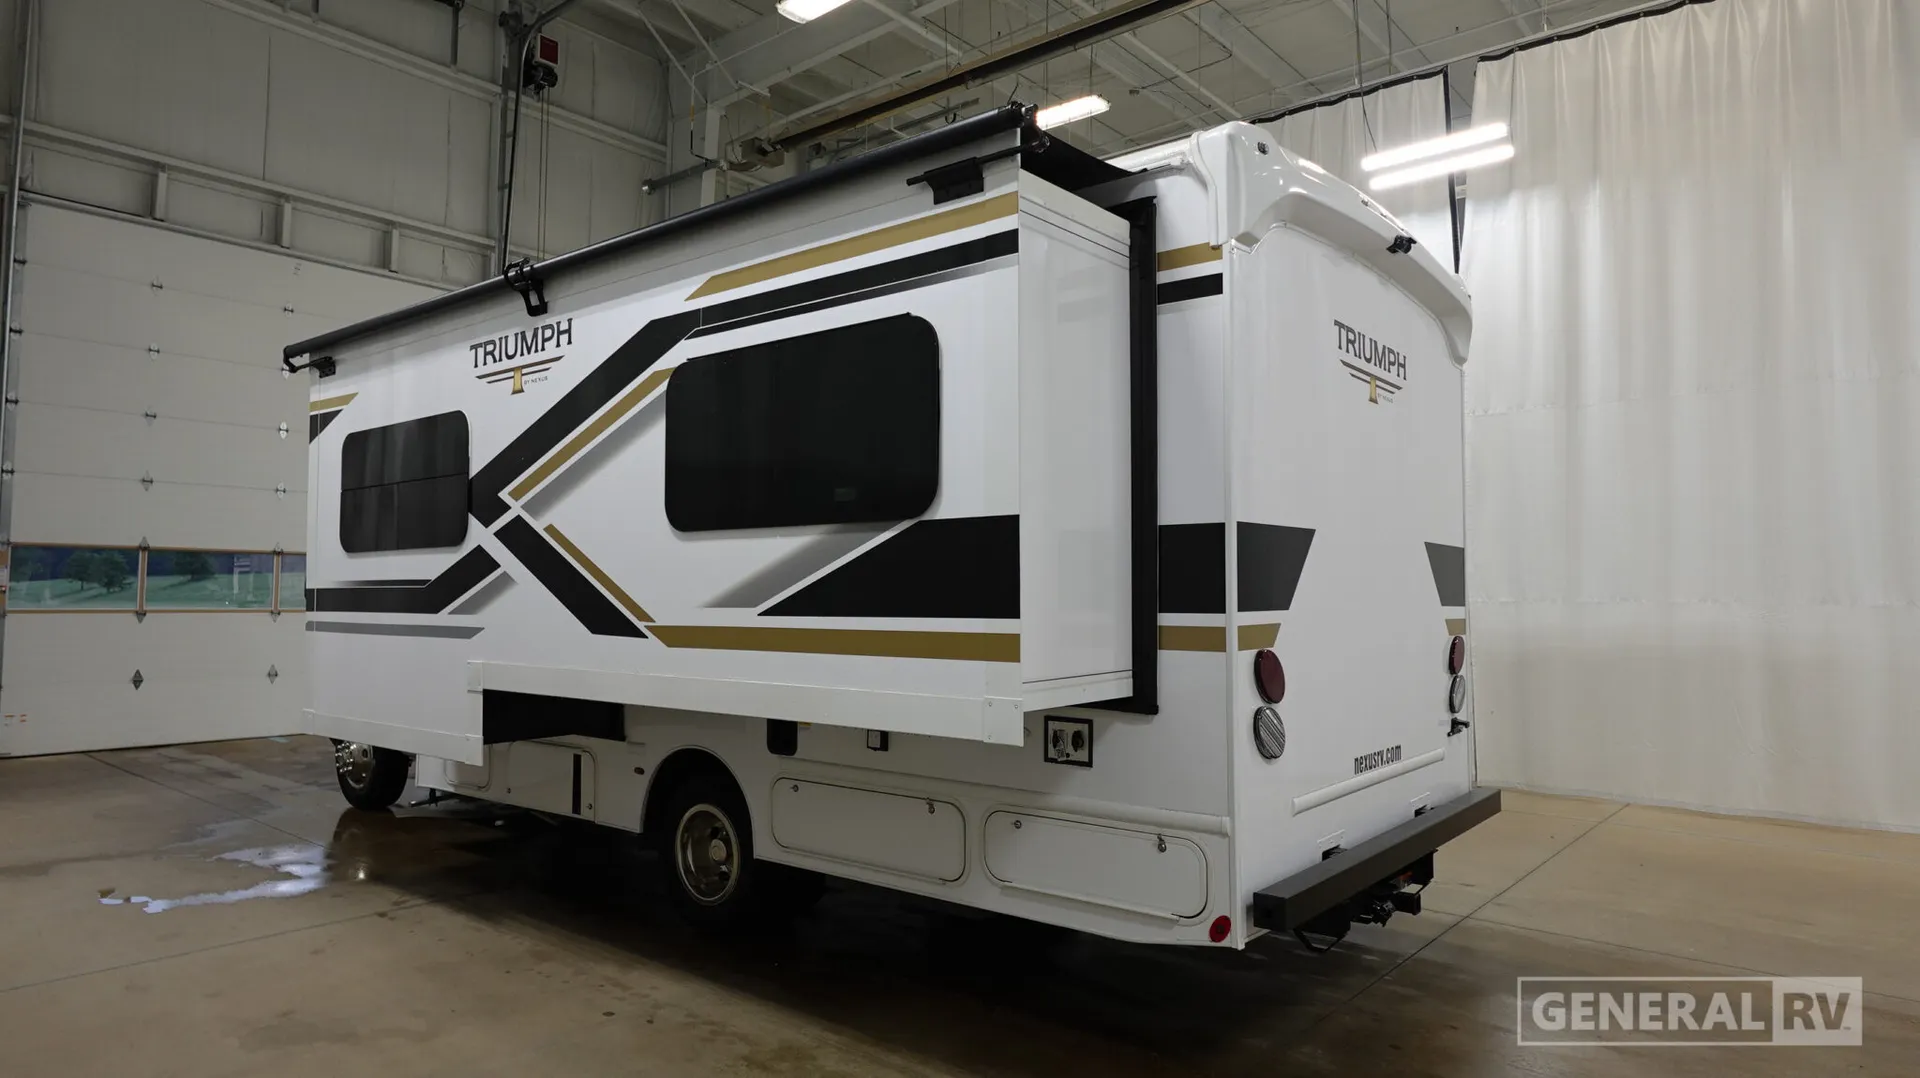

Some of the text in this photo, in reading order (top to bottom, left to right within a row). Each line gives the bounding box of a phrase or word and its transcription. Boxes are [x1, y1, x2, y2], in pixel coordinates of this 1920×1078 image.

[469, 318, 573, 368] TRIUMPH
[1333, 319, 1407, 381] TRIUMPH
[1354, 744, 1402, 775] nexusrv.com
